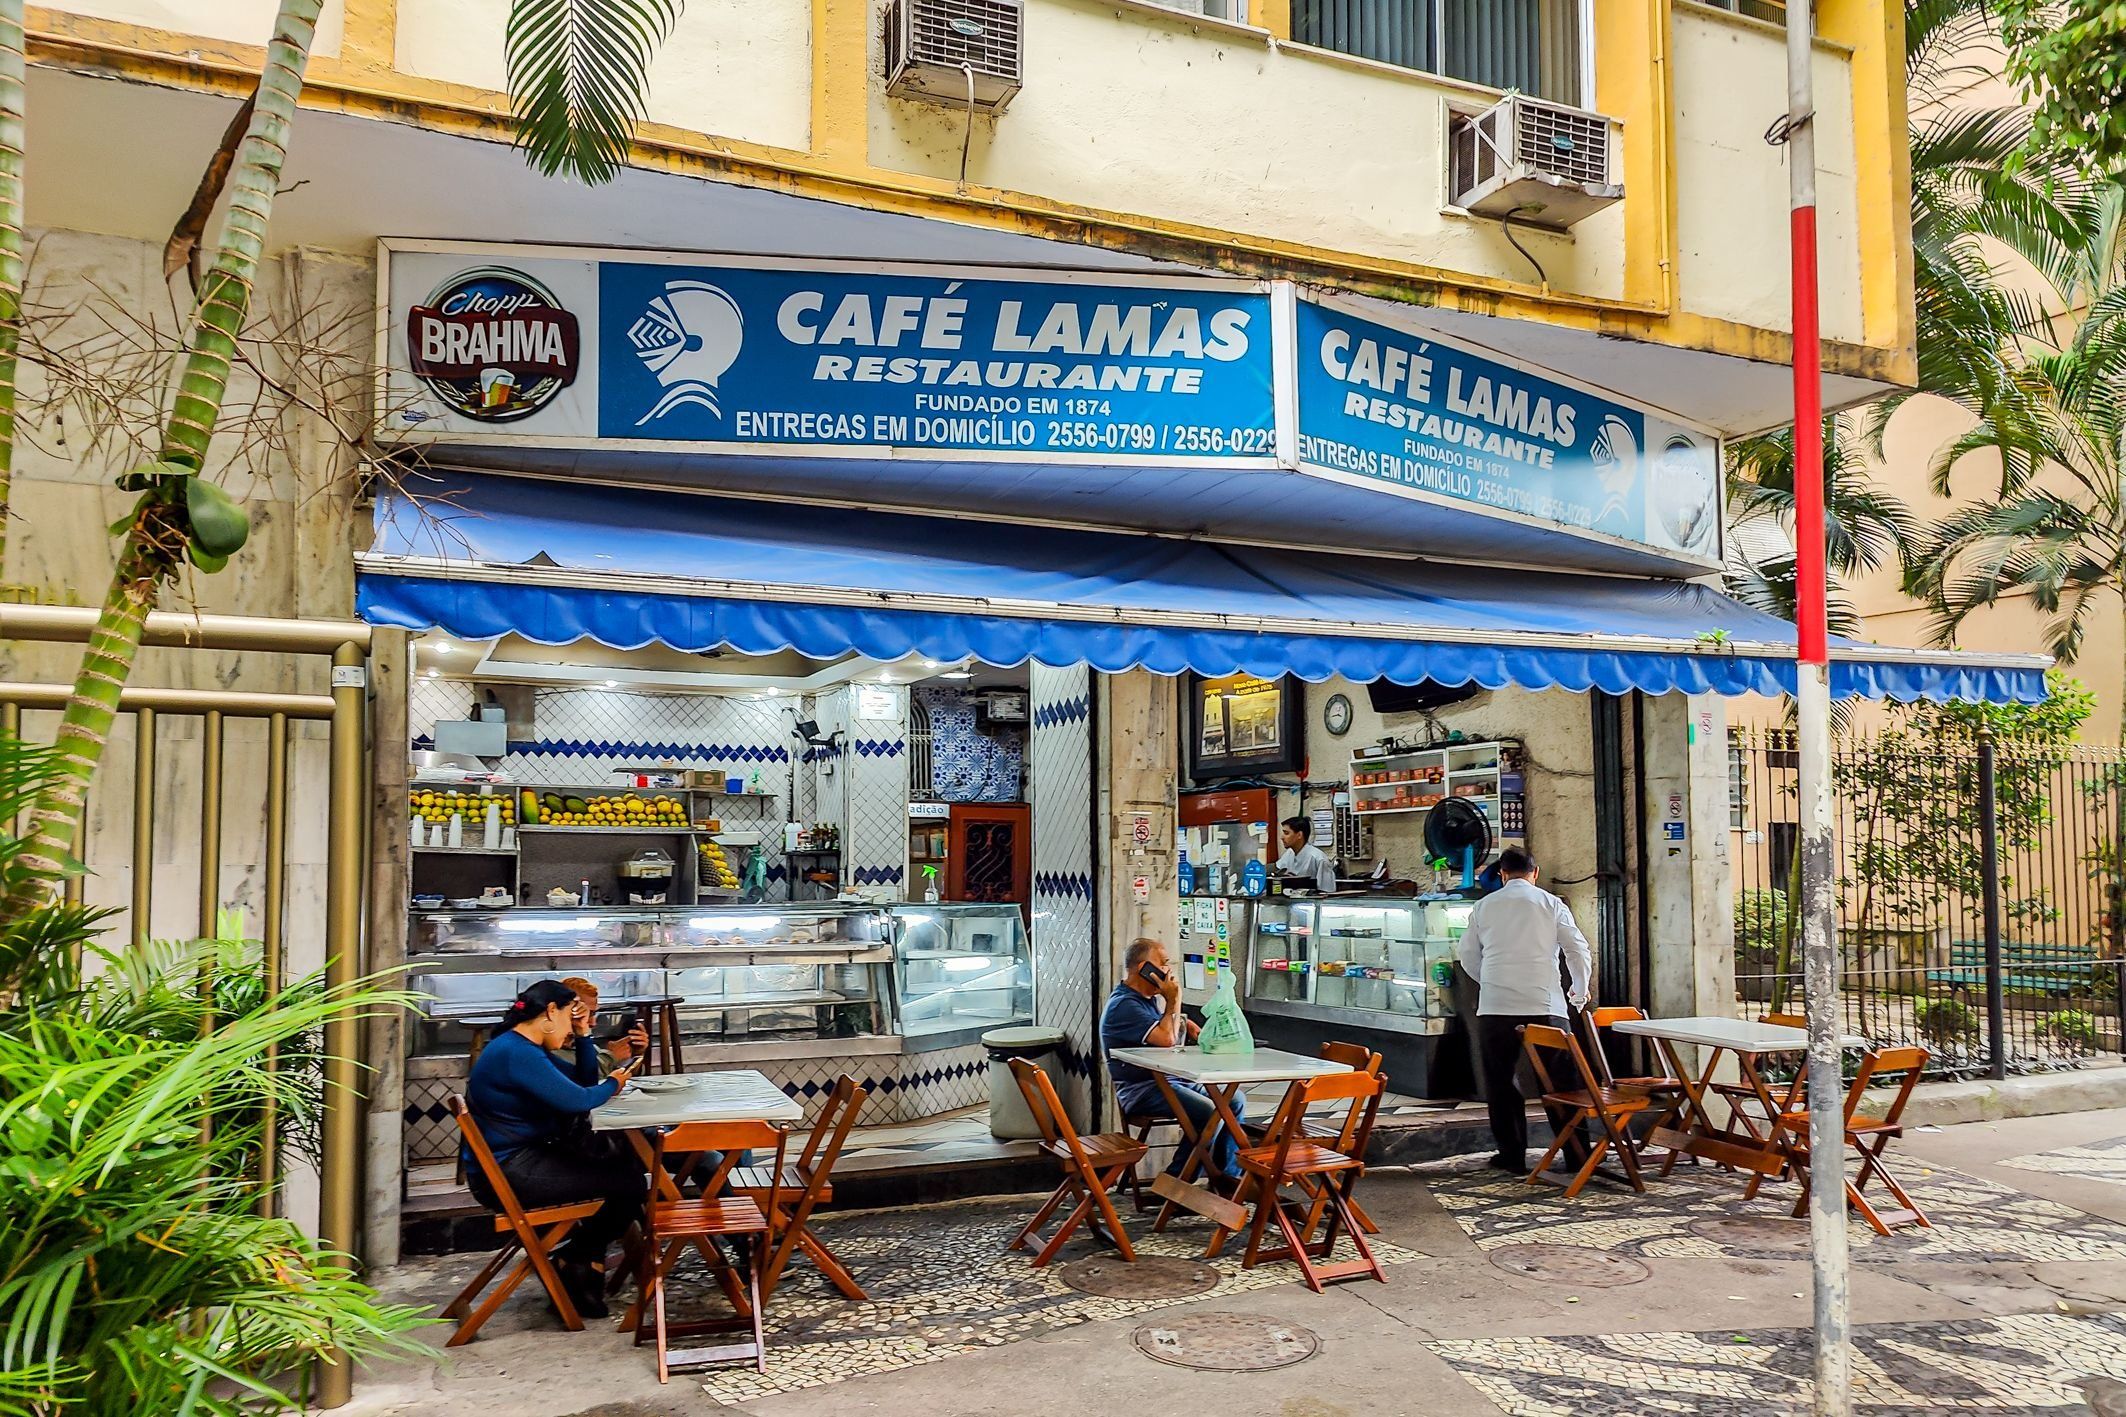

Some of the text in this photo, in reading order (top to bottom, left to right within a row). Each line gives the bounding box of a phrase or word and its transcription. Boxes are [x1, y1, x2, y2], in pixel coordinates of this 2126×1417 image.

[441, 290, 542, 316] Chopp
[776, 282, 1252, 362] CAFÉ LAMAS
[421, 317, 566, 367] BRAHMA
[813, 355, 1204, 394] RESTAURANTE
[1320, 329, 1576, 447] CAFÉ LAMAS
[915, 394, 1112, 416] FUNDADO EM 1874
[736, 411, 866, 440] ENTREGAS
[873, 415, 907, 441] EM
[915, 414, 1036, 446] DOMICÍLIO
[1047, 421, 1156, 449] 2556-0799
[1174, 426, 1277, 454] 2556-0229
[1344, 391, 1555, 470] RESTAURANTE
[1298, 433, 1378, 475] ENTREGAS
[1381, 453, 1401, 480] EM
[1404, 465, 1471, 497] DOMICÍLIO
[1404, 438, 1510, 479] FUNDADO EM 1874
